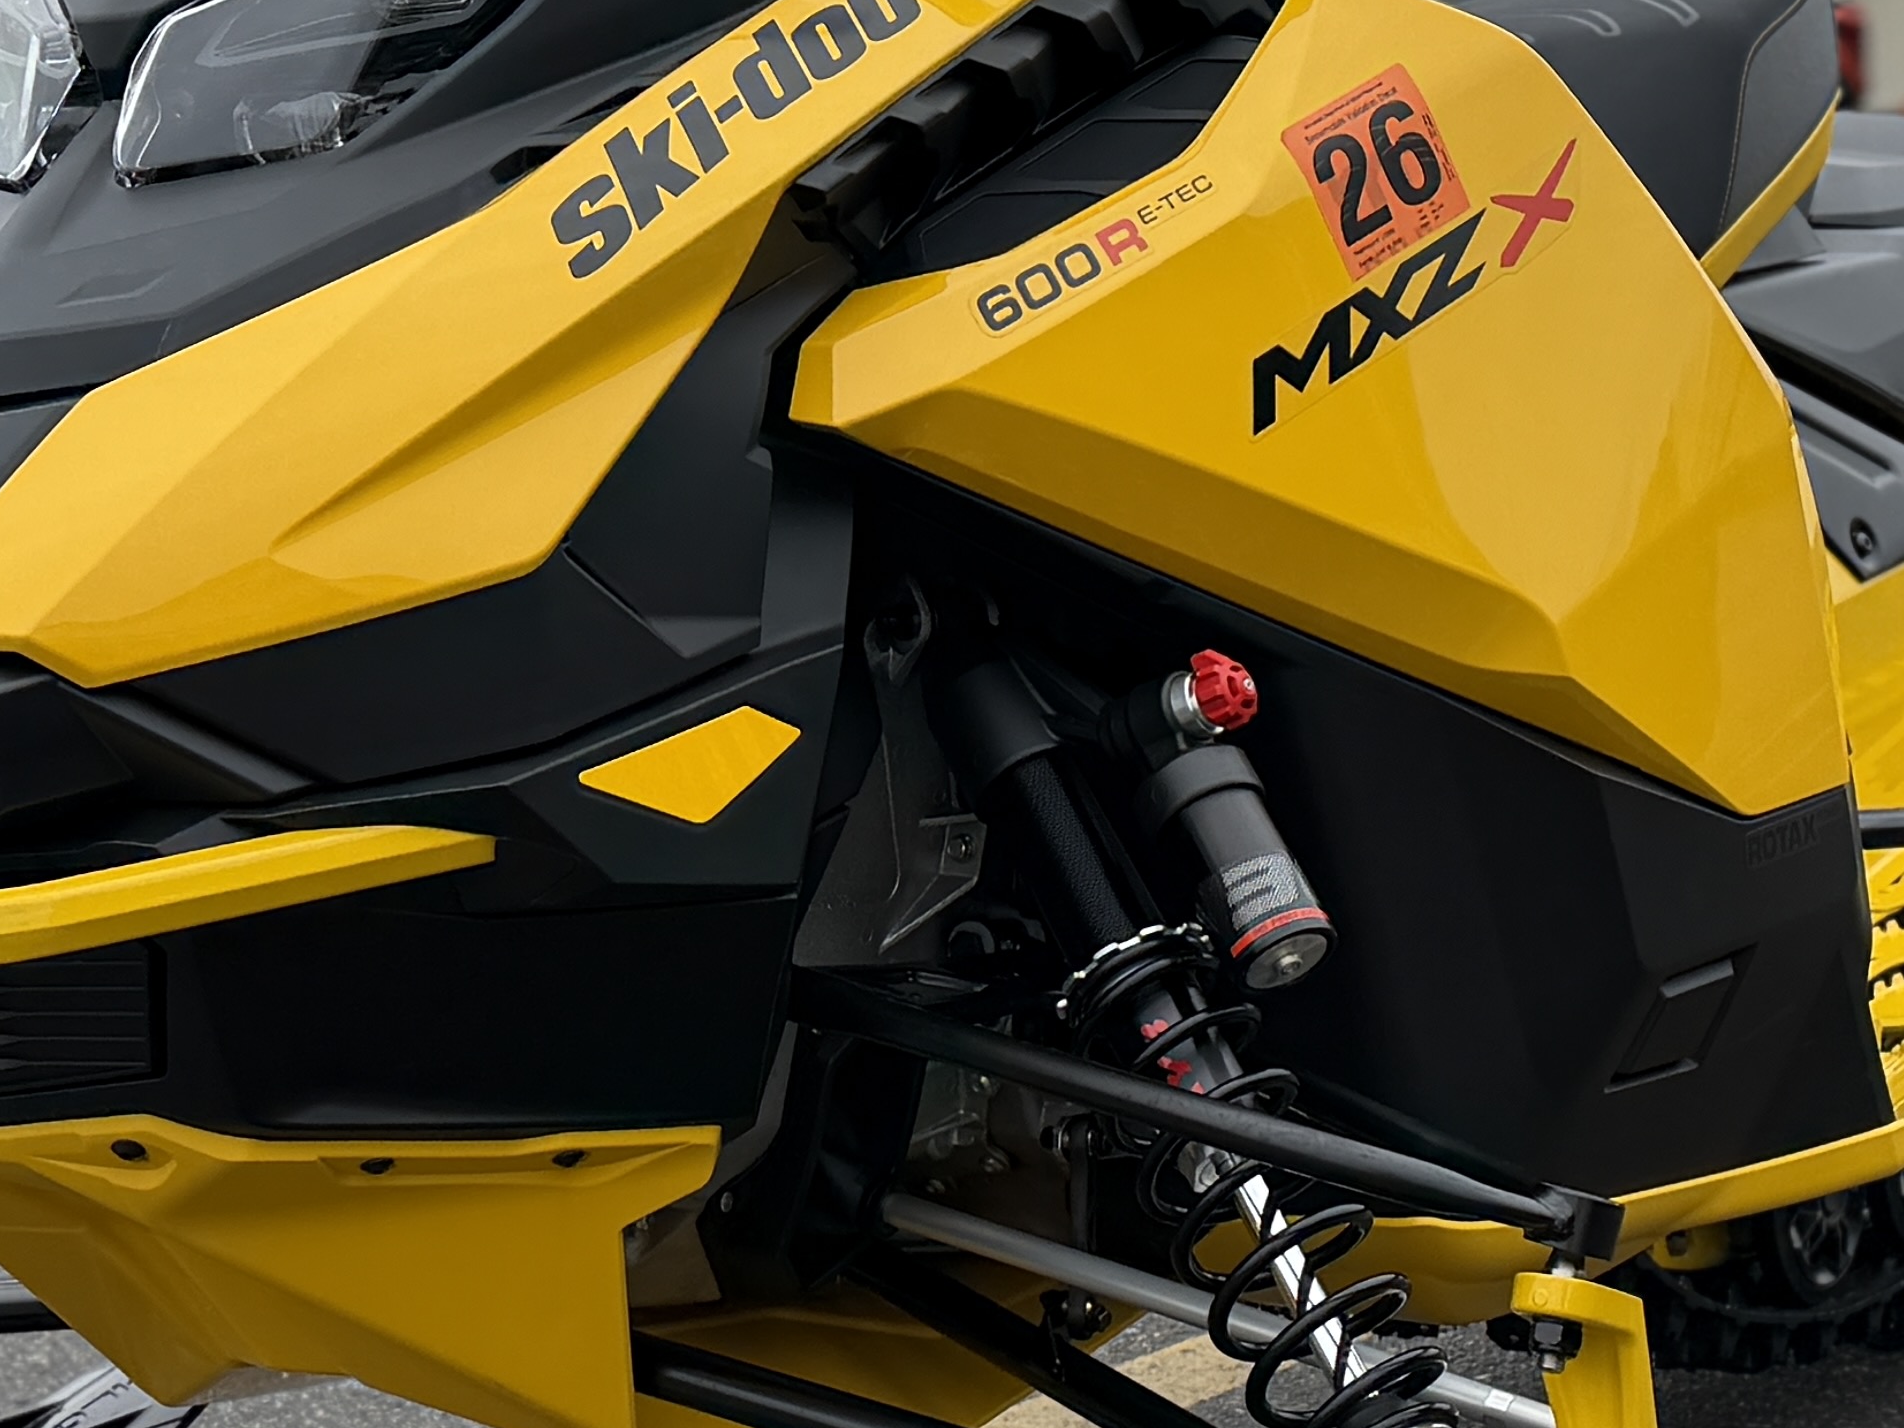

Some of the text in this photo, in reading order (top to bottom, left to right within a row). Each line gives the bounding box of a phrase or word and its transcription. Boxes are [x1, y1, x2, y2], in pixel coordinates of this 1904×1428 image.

[1313, 100, 1442, 248] 26
[977, 174, 1213, 332] 600R E-TEC
[1252, 208, 1487, 437] MXZ
[1748, 813, 1817, 866] ROTAX
